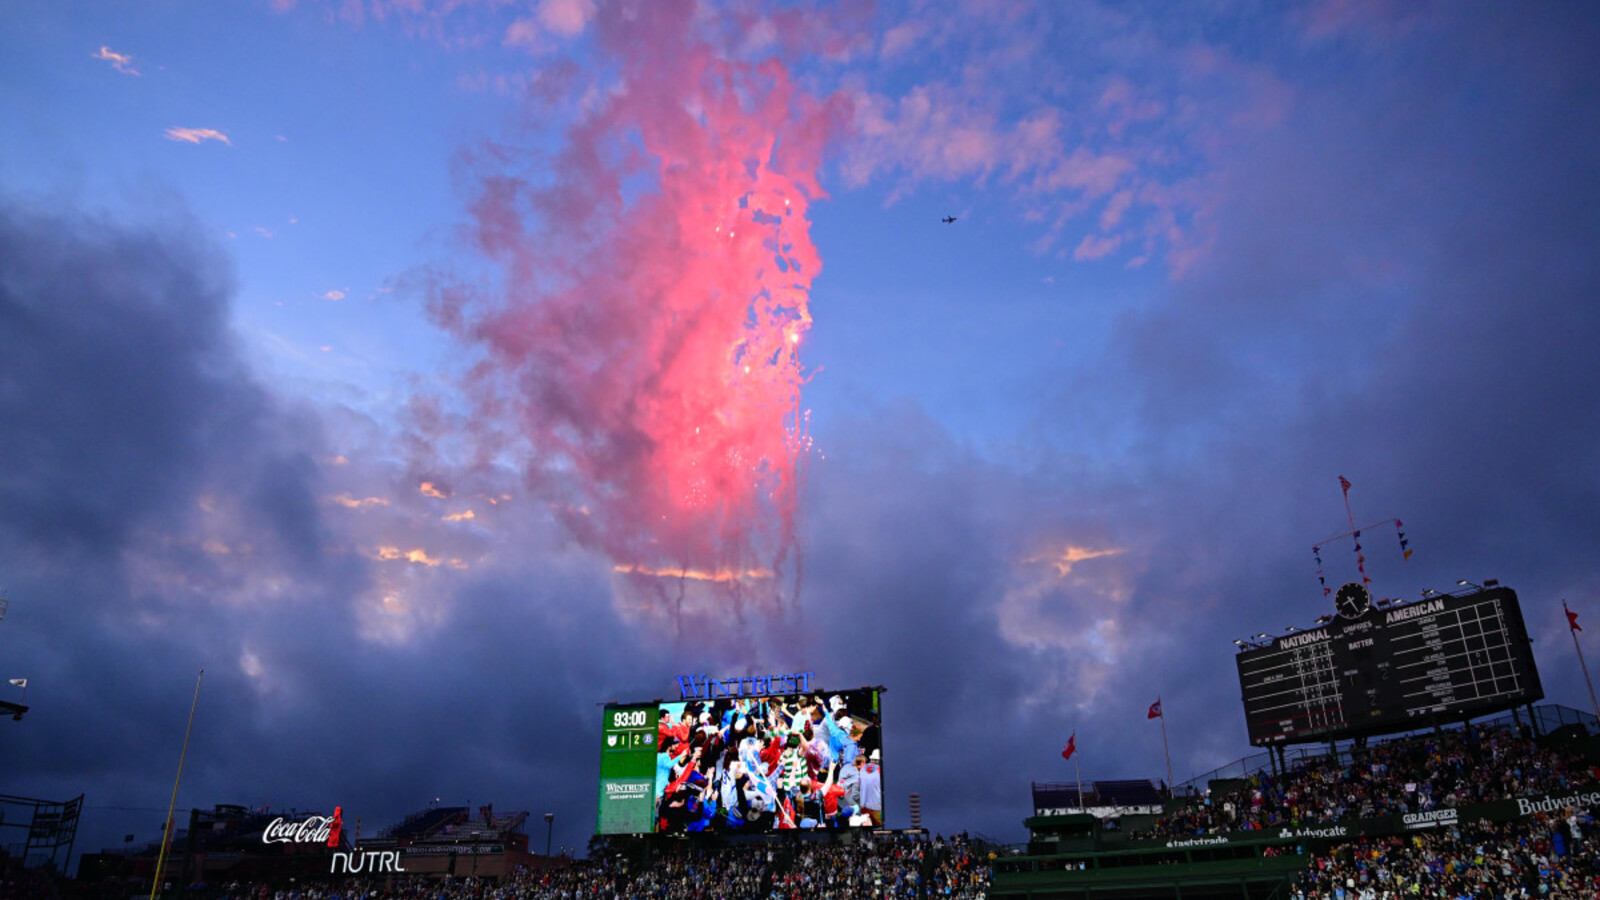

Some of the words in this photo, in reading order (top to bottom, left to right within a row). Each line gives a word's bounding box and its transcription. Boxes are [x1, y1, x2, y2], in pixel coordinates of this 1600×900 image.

[1385, 599, 1445, 625] AMERICAN
[1280, 628, 1331, 650] NATIONAL
[1348, 638, 1374, 651] BATTER
[676, 672, 816, 699] WINTRUST
[614, 711, 647, 727] 93:00
[634, 734, 640, 745] 2
[606, 783, 650, 793] WINTRUST
[1402, 808, 1458, 824] GRAINGER
[1295, 825, 1347, 838] Advocate
[330, 847, 405, 874] NÜTRL
